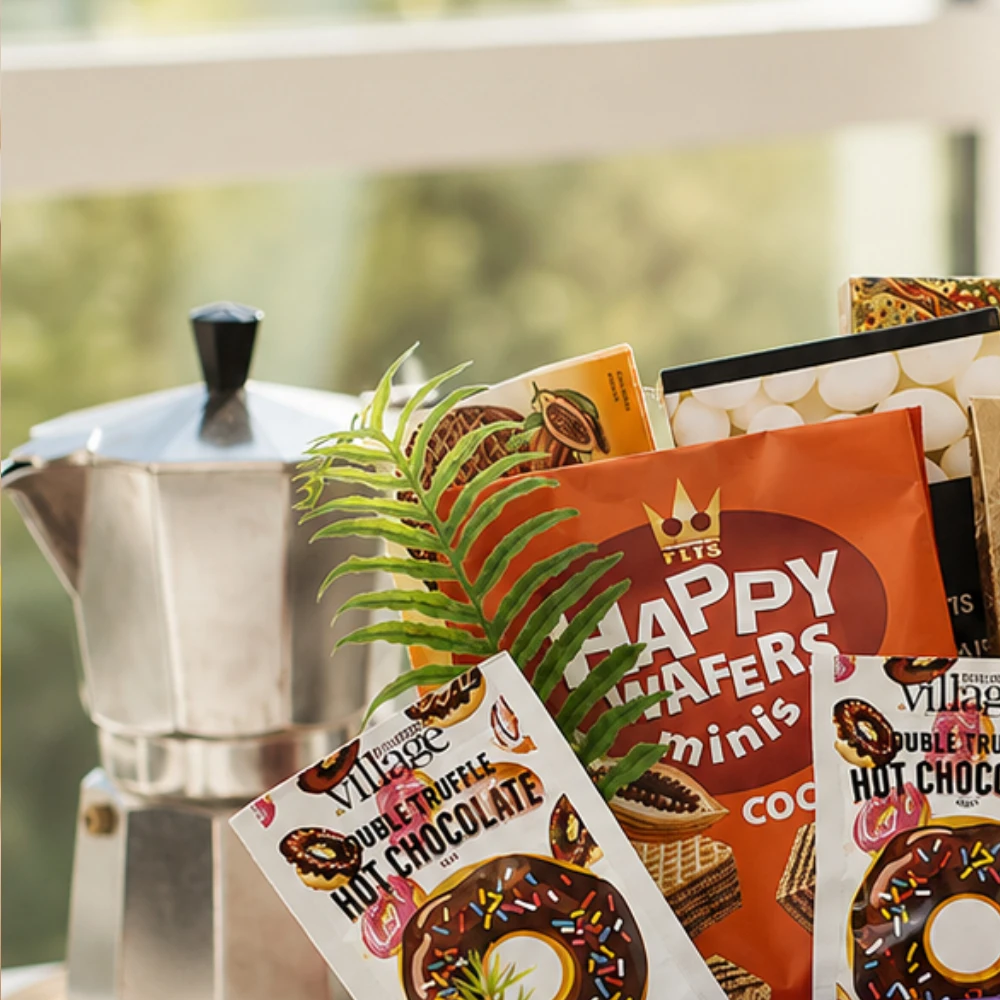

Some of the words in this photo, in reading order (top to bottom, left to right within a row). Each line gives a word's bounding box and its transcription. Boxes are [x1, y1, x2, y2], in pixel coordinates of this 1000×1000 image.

[604, 622, 840, 721] WAFERS
[657, 697, 800, 766] minis
[406, 752, 496, 823] TRUFFLE
[850, 761, 906, 802] HOT
[330, 860, 393, 921] HOT
[385, 772, 544, 879] CHOCOLATE
